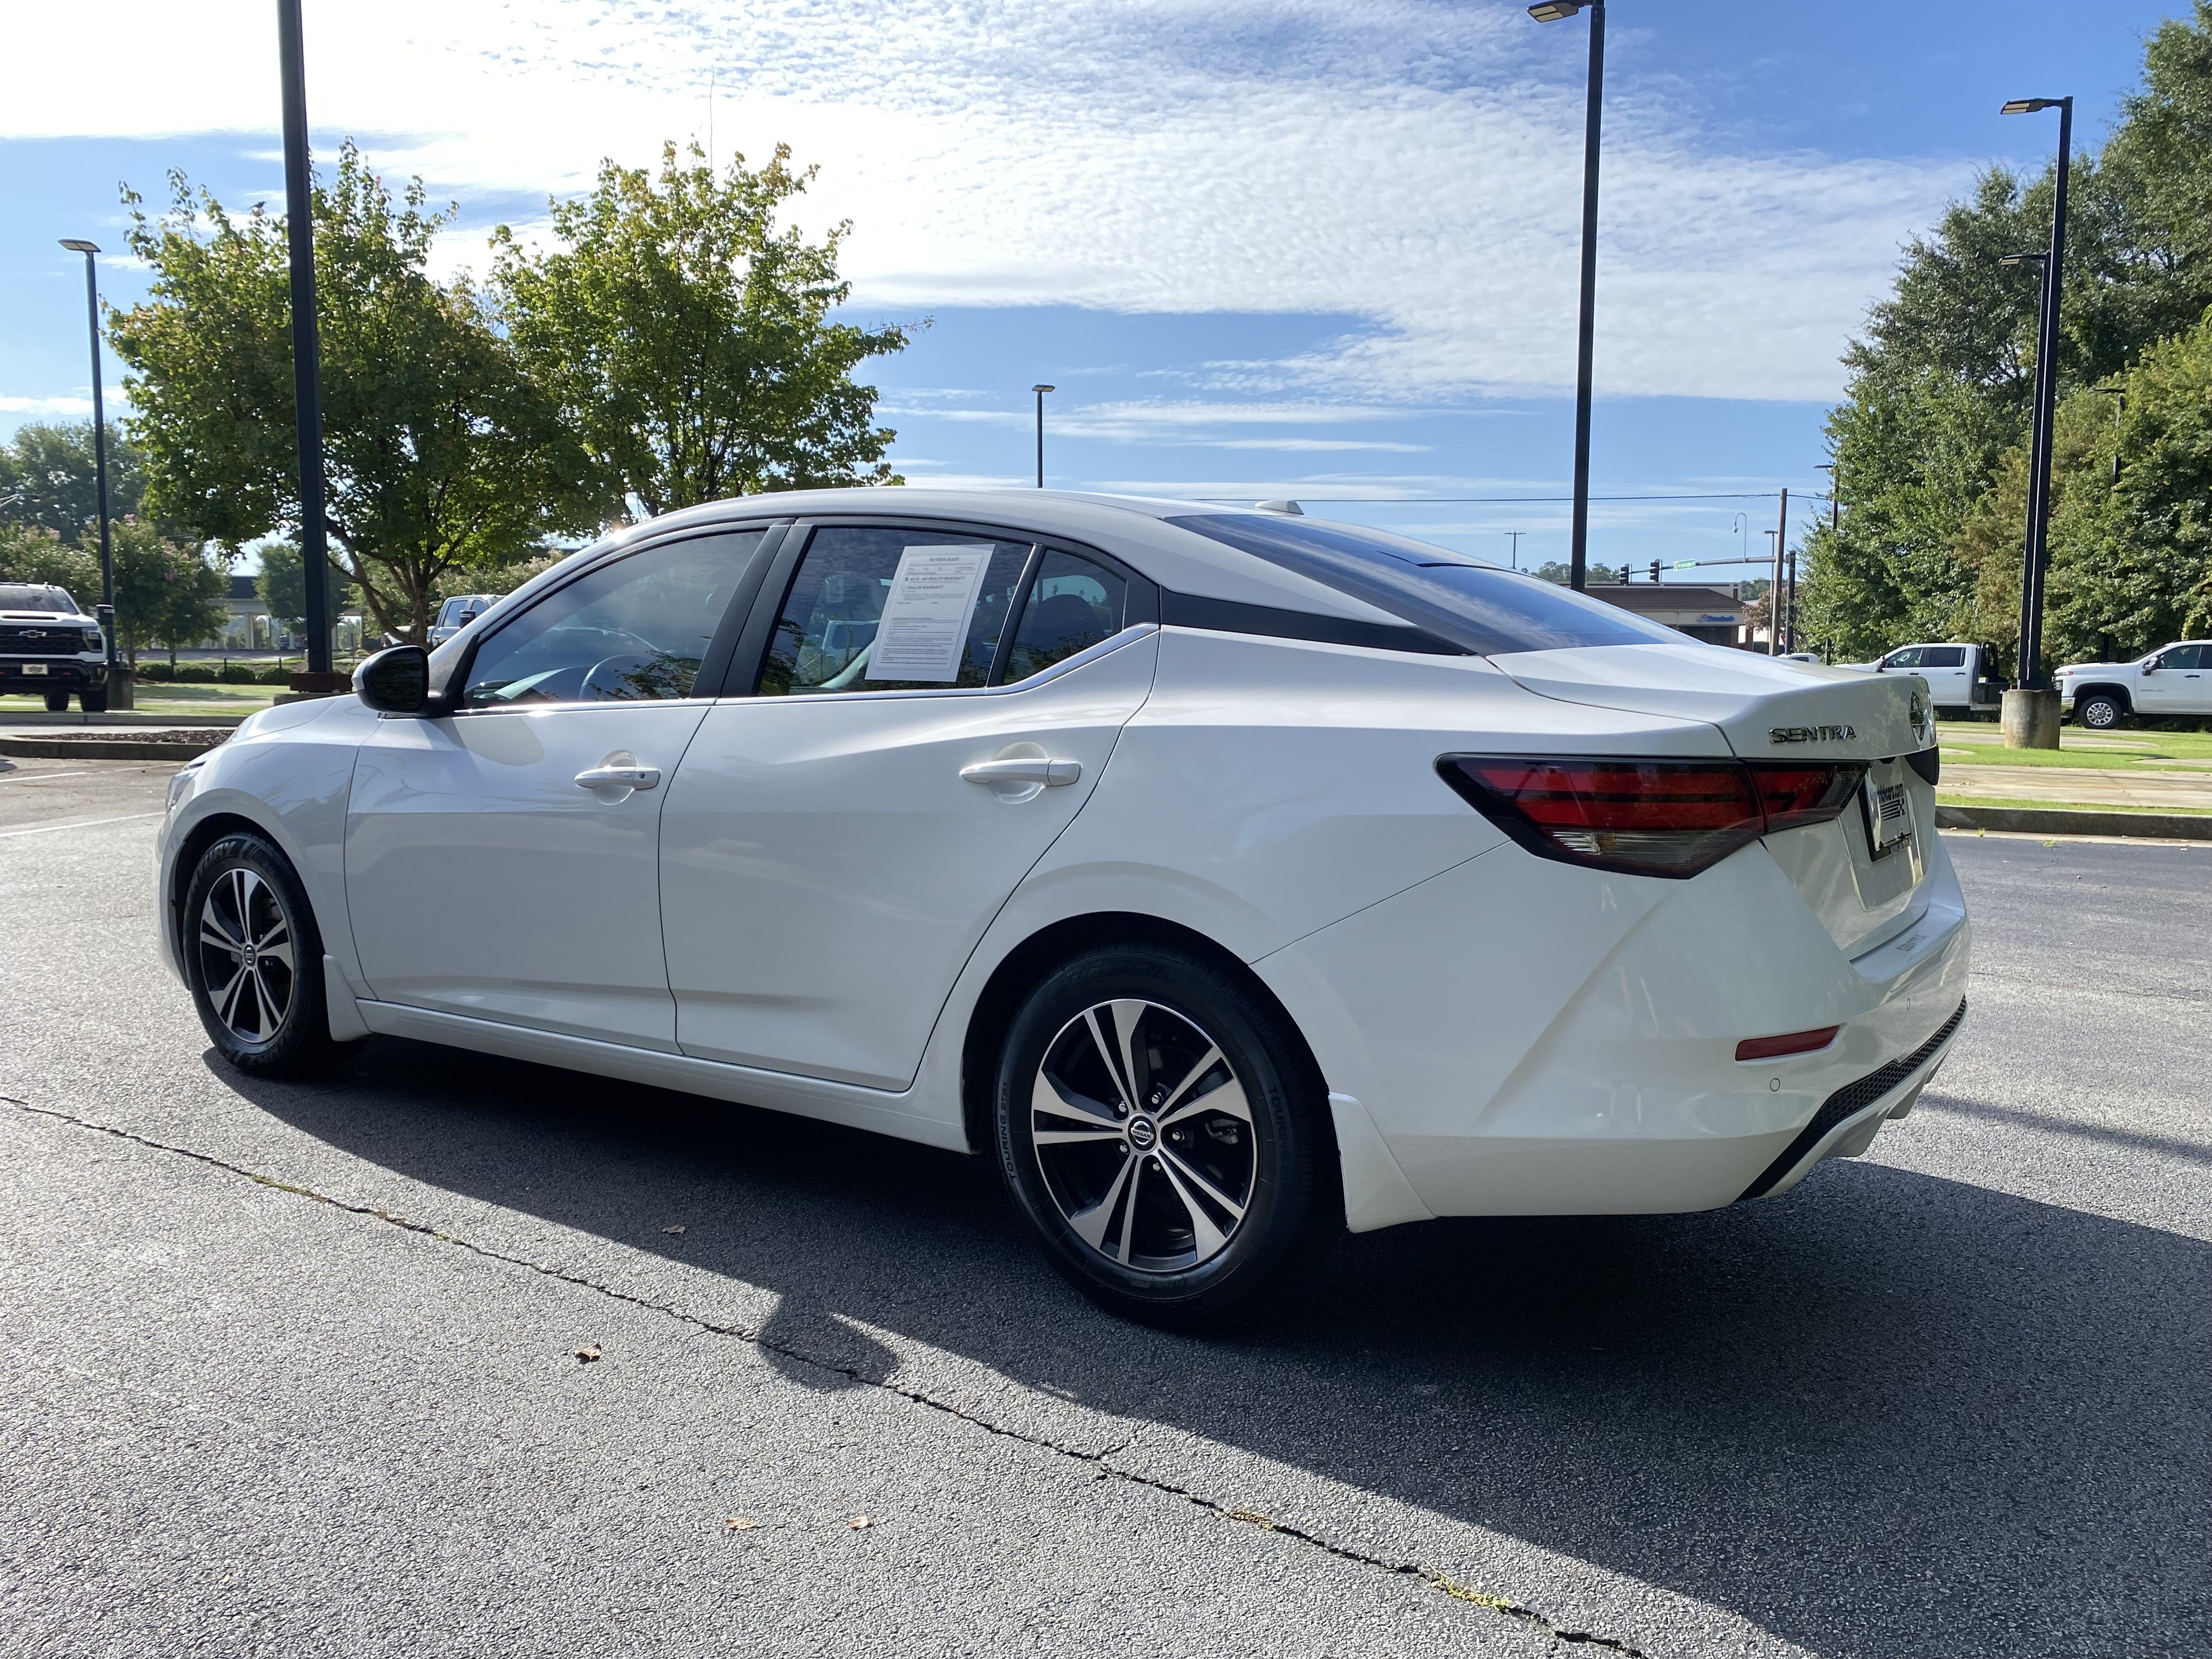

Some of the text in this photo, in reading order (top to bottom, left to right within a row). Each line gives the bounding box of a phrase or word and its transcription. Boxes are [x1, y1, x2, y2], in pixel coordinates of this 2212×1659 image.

[1768, 725, 1857, 744] SENTRA
[1132, 1129, 1152, 1139] NISSAN
[1000, 1114, 1016, 1182] TOURING
